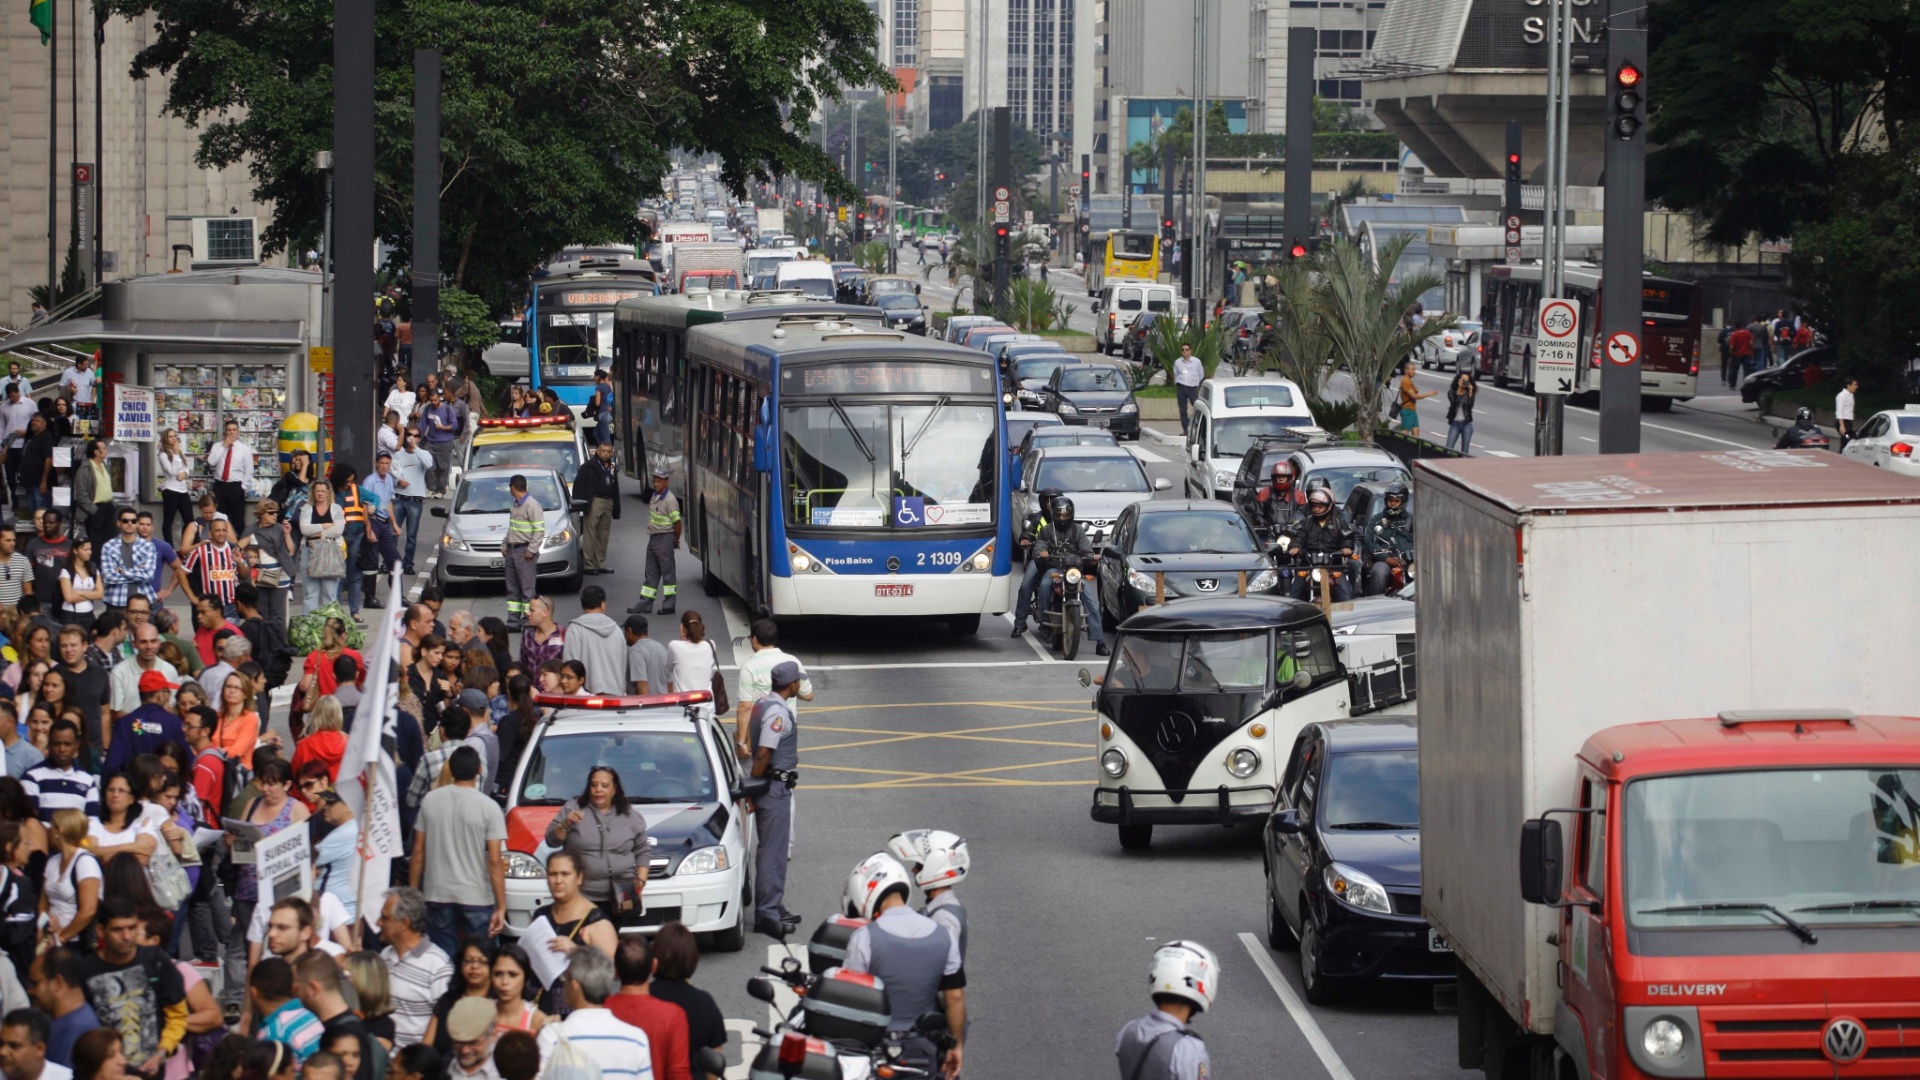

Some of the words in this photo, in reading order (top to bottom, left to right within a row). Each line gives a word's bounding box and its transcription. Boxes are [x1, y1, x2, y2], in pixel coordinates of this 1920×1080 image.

[78, 187, 86, 210] Prime
[674, 234, 708, 243] Design
[1538, 340, 1577, 349] DOMINGO
[1540, 350, 1564, 359] 7-16
[1567, 351, 1573, 360] h
[121, 401, 147, 412] CHICO
[118, 412, 152, 423] XAVIER
[825, 557, 845, 565] Piso
[846, 557, 873, 565] Baixo
[916, 553, 926, 566] 2
[930, 552, 962, 566] 1309
[264, 833, 303, 862] SUBSEDE
[294, 848, 311, 863] SUL
[1647, 983, 1727, 996] DELIVERY
